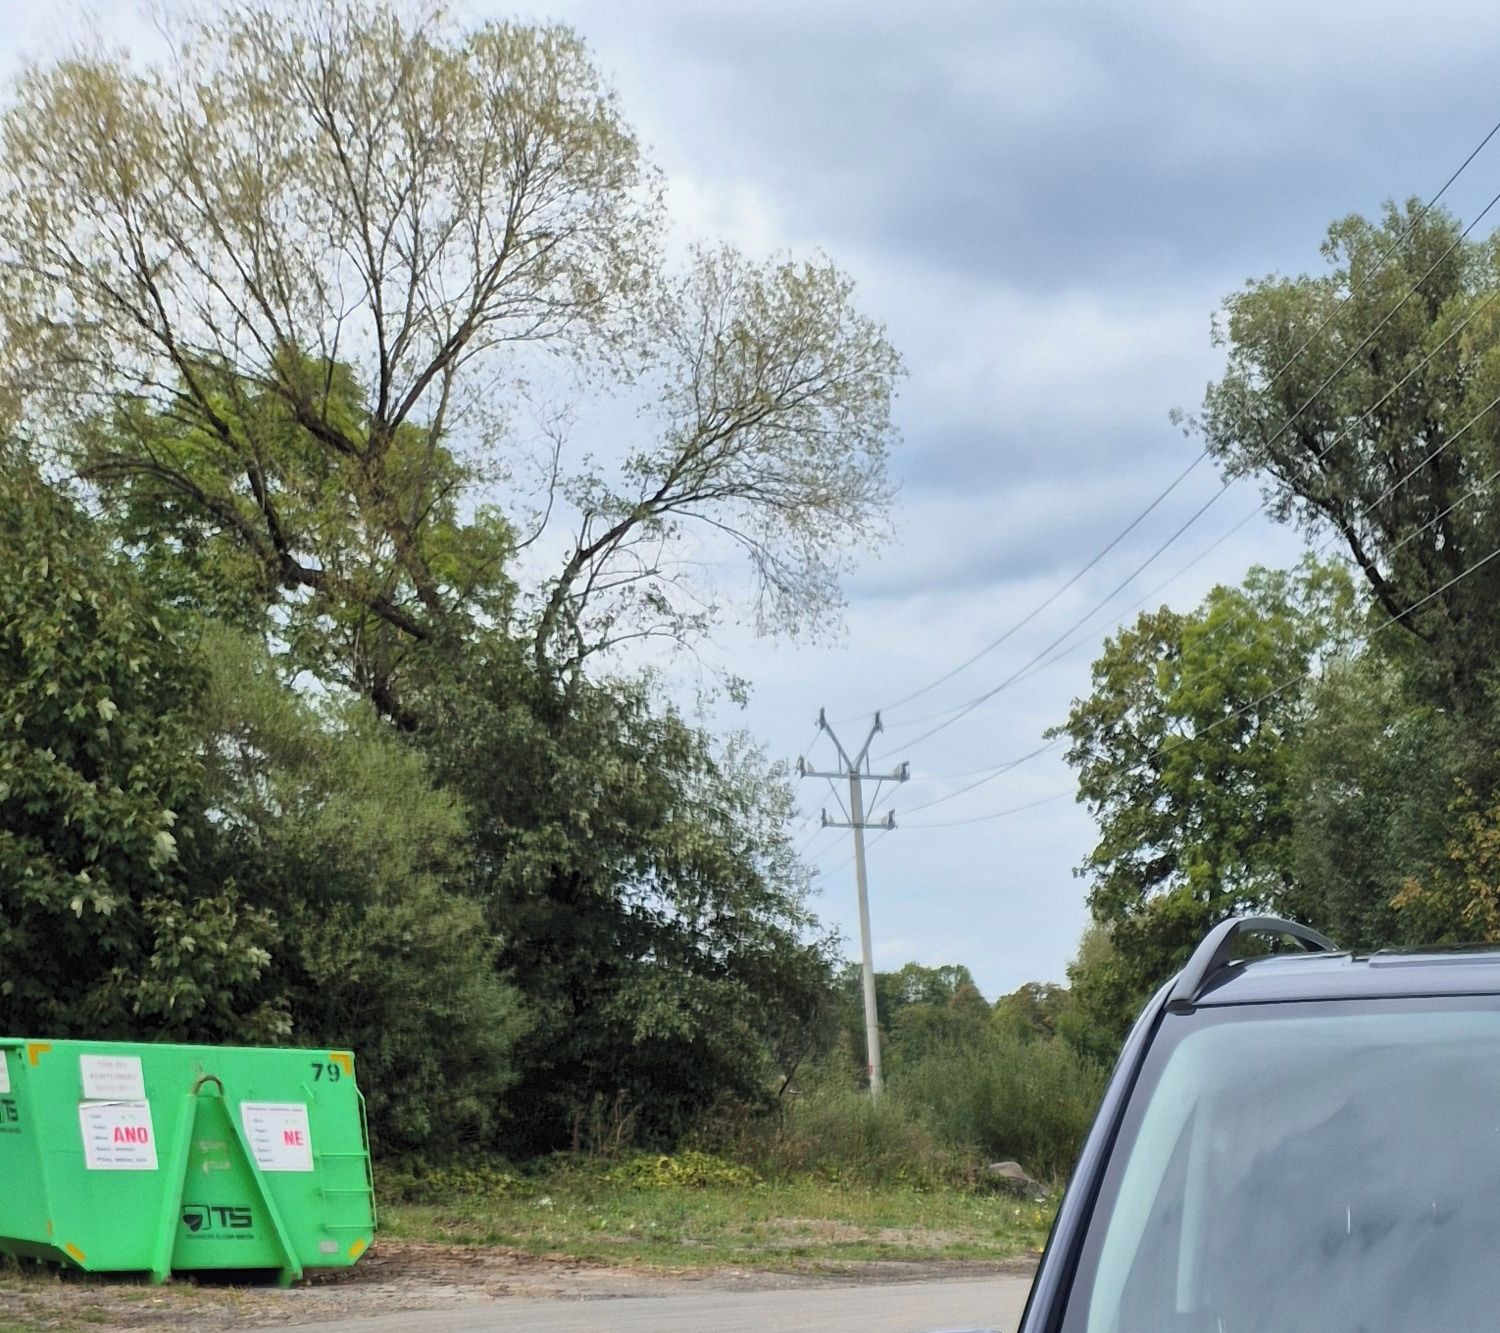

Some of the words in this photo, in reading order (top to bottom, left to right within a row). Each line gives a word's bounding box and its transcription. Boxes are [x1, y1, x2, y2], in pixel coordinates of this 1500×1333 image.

[311, 1063, 340, 1082] 79
[114, 1127, 148, 1143] ANO
[284, 1130, 304, 1146] NE
[211, 1206, 253, 1229] TS
